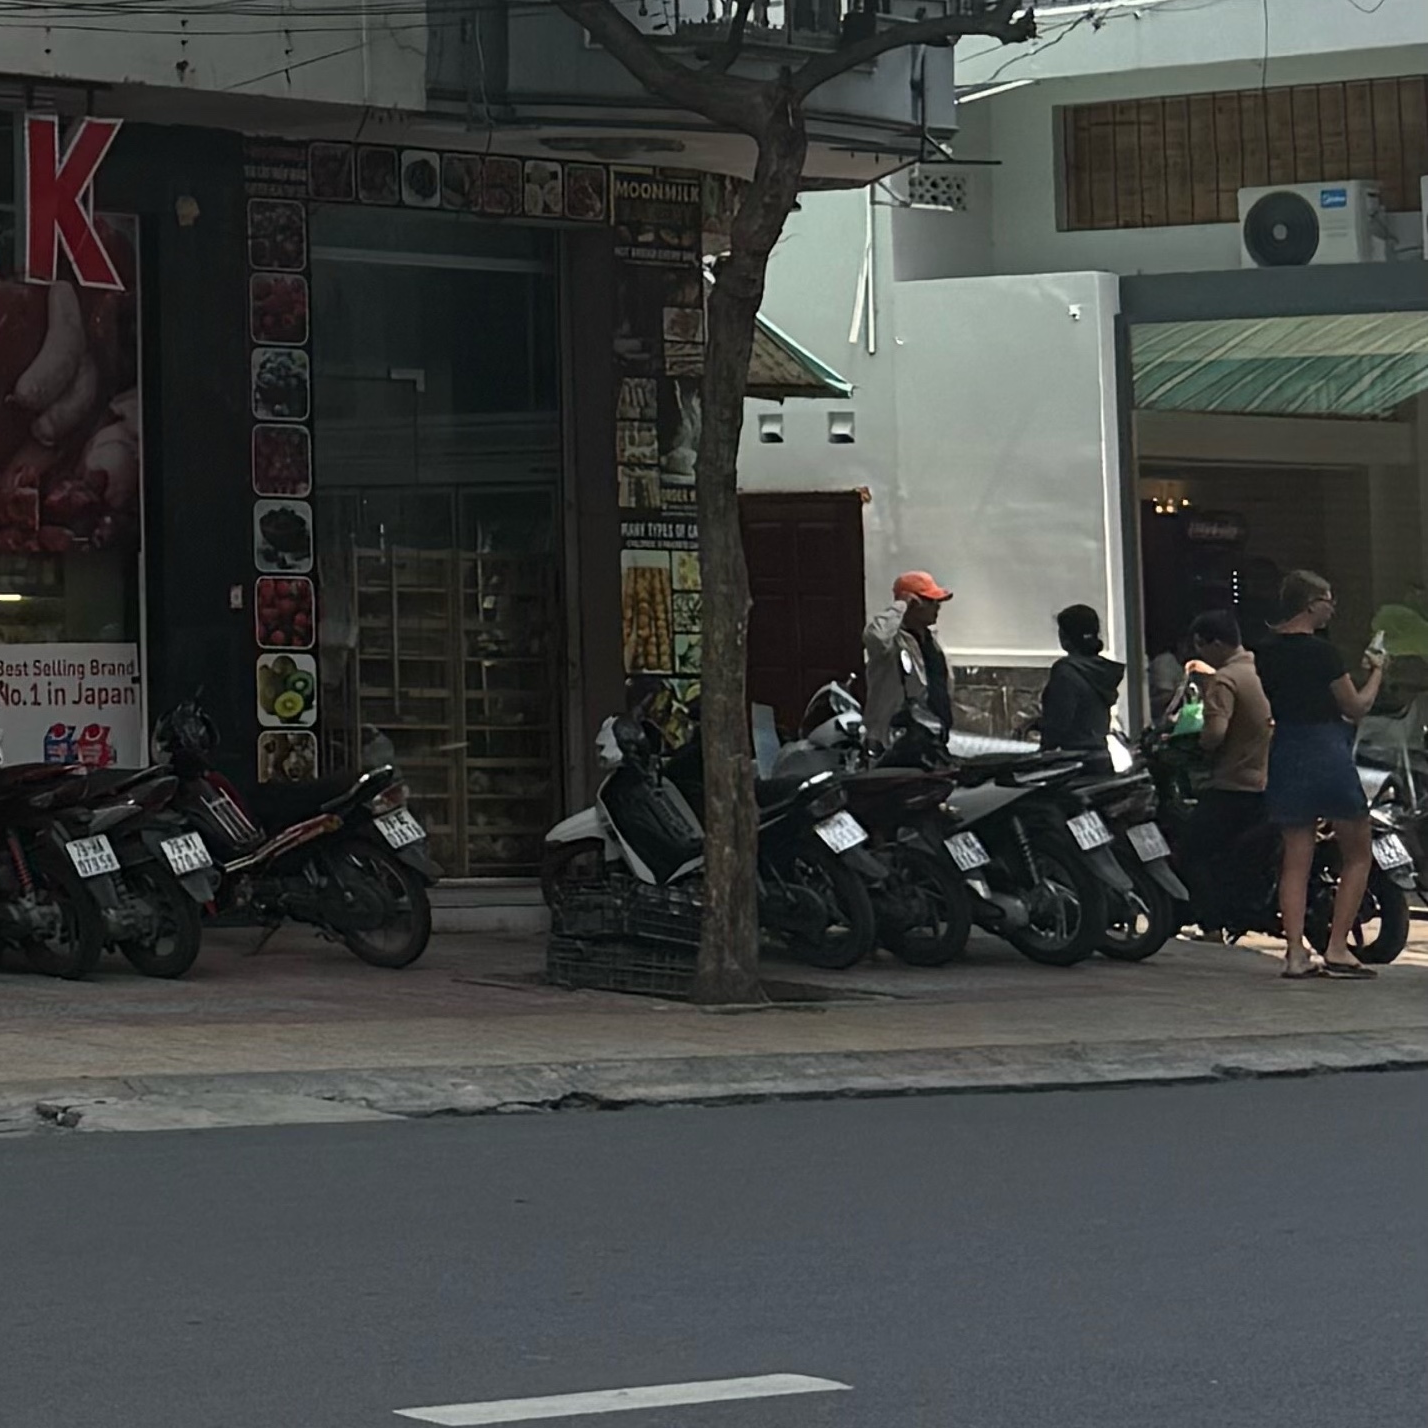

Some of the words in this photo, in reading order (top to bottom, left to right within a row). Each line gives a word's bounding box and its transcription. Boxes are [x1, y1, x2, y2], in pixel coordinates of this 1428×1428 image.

[614, 179, 700, 203] MOONMILK
[33, 659, 85, 681] Selling
[90, 659, 135, 676] Brand
[48, 682, 66, 706] in
[72, 682, 136, 710] Japan
